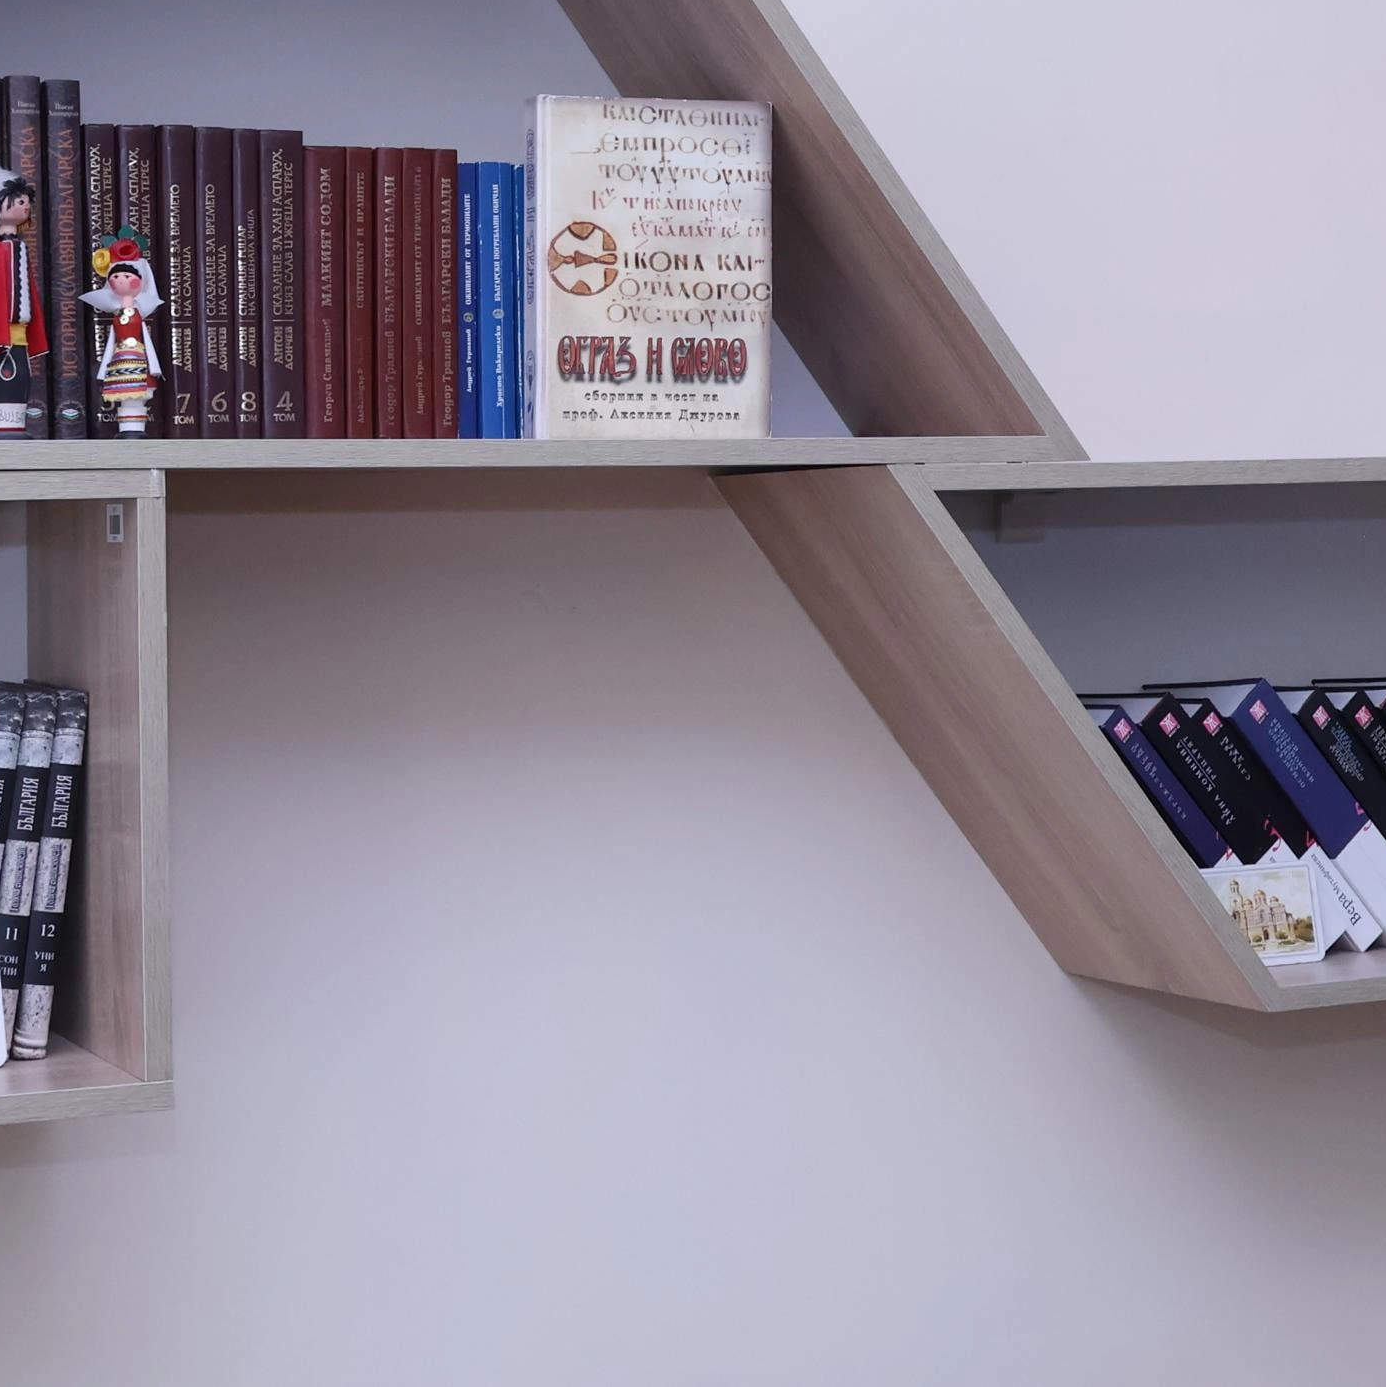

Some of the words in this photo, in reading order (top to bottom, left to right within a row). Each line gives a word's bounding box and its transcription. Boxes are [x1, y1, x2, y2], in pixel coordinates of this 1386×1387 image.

[102, 157, 112, 191] ТЕРЕС
[140, 159, 151, 191] ТЕРЕС
[282, 162, 293, 195] ТЕРЕС
[169, 184, 180, 235] ВРЕМЕТО
[204, 184, 215, 234] ВРЕМЕТО
[320, 167, 333, 226] СОДОМ
[384, 176, 397, 233] БАЛАДИ
[441, 177, 455, 235] БАЛАДИ
[92, 207, 102, 230] ХАН
[129, 205, 140, 233] ХАН
[271, 207, 283, 234] ХАН
[283, 197, 294, 237] ЖРЕЦА
[170, 237, 181, 253] ЗА
[205, 237, 215, 252] ЗА
[272, 236, 283, 251] ЗА
[182, 246, 192, 297] САМУИЛ
[217, 245, 227, 296] САМУИЛ
[284, 252, 294, 283] СЛАВ
[320, 230, 333, 307] МАЛКИЯТ
[385, 235, 395, 323] БЪЛГАРСКИ
[441, 238, 453, 324] БЪЛГАРСКИ
[182, 300, 192, 317] НА
[218, 299, 228, 316] НА
[284, 285, 294, 315] КНЯЗ
[60, 300, 76, 379] ИСТОРИЯ
[170, 328, 182, 366] АНТОН
[183, 328, 193, 372] ДОНЧЕВ
[207, 327, 218, 364] АНТОН
[218, 327, 228, 371] ДОНЧЕВ
[273, 326, 284, 365] АНТОН
[284, 326, 294, 371] ДОНЧЕВ
[177, 393, 191, 413] 7
[211, 391, 227, 413] 6
[240, 391, 257, 412] 8
[276, 391, 294, 411] 4
[584, 390, 644, 403] сборник
[664, 393, 696, 403] чест
[702, 393, 720, 403] на
[173, 415, 194, 424] ТОМ
[207, 415, 230, 423] ТОМ
[240, 415, 259, 423] ТОМ
[273, 415, 295, 423] ТОМ
[562, 408, 604, 423] проф.
[611, 409, 673, 421] Аксиния
[678, 409, 741, 423] Джурова
[1173, 742, 1214, 792] КОМНИНА
[17, 777, 39, 831] БЪЛГАРИЯ
[51, 774, 72, 828] БЪЛГАРИЯ
[1338, 892, 1362, 926] Вера
[4, 927, 18, 940] 11
[40, 924, 55, 937] 12
